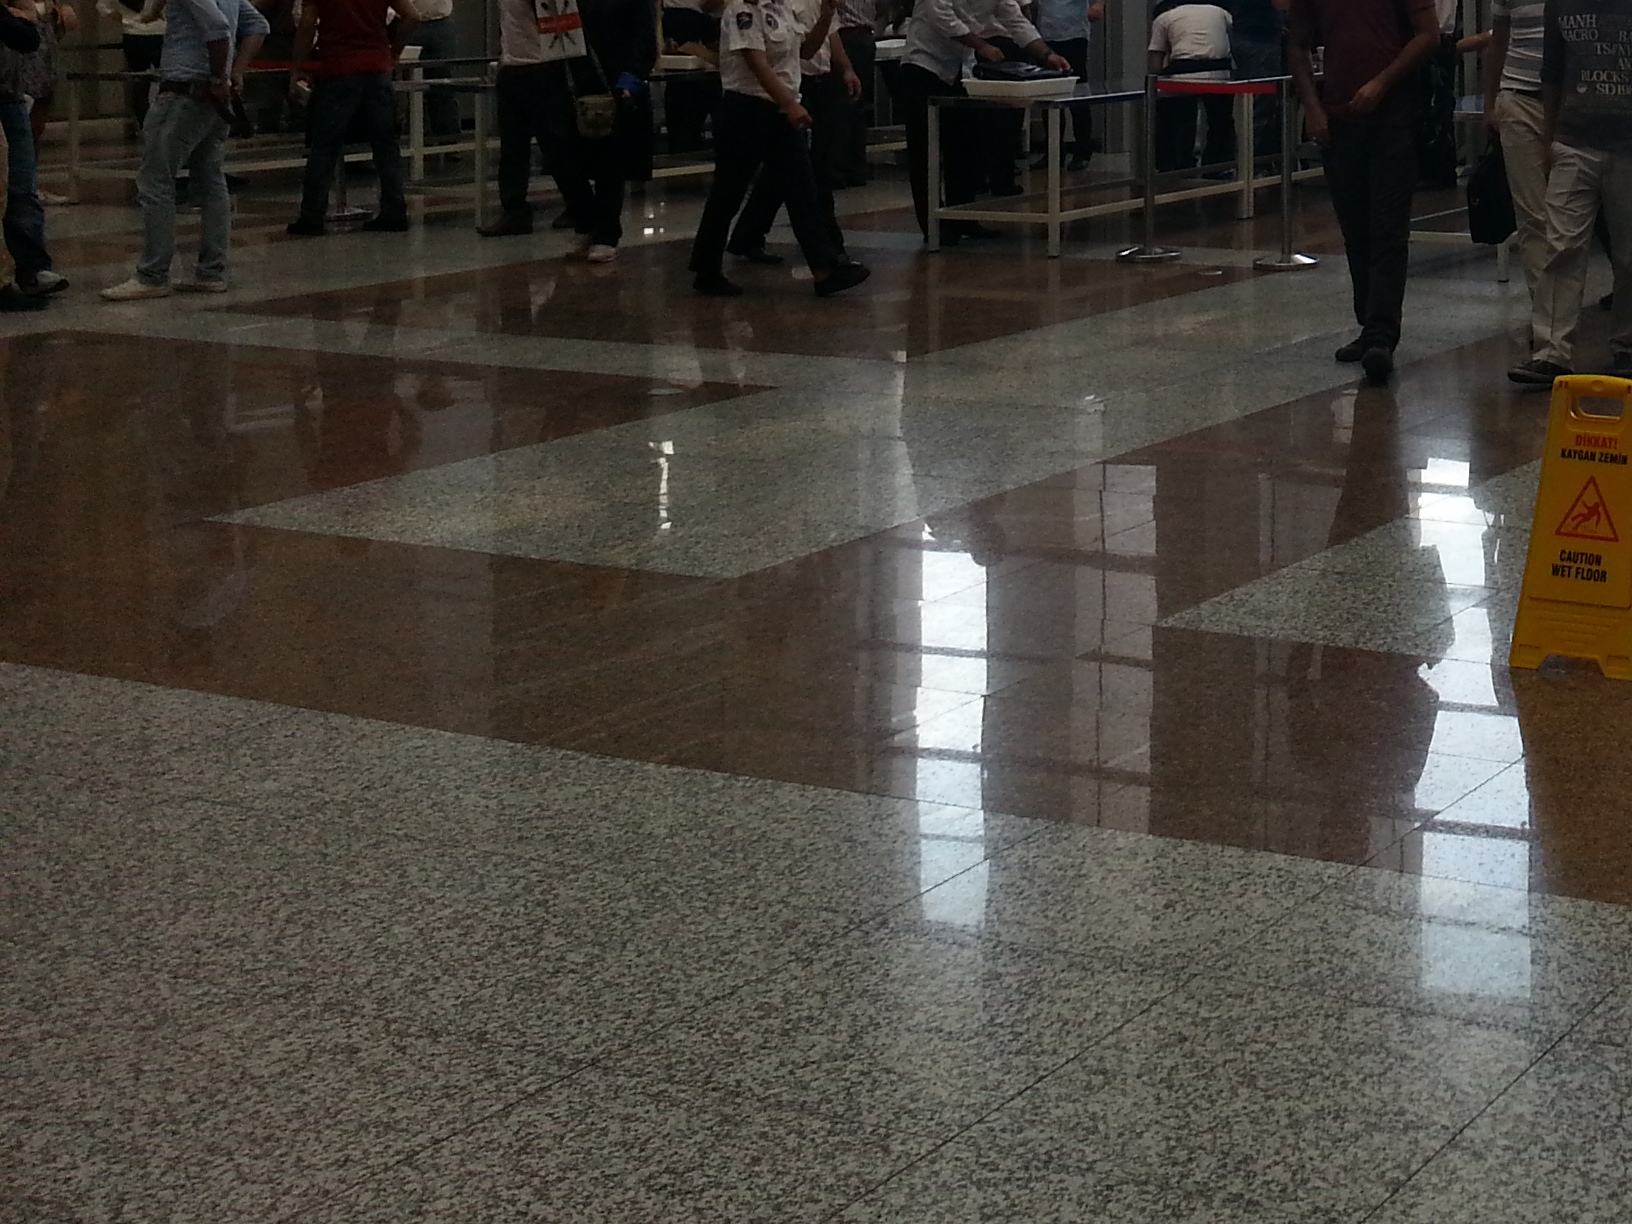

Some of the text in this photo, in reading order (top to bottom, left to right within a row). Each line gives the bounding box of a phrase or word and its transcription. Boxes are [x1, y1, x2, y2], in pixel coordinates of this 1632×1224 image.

[1581, 69, 1630, 82] BLOCKS
[1560, 447, 1596, 462] KAYGAN
[1559, 549, 1602, 566] CAUTION
[1552, 564, 1607, 583] WET FLOOR
